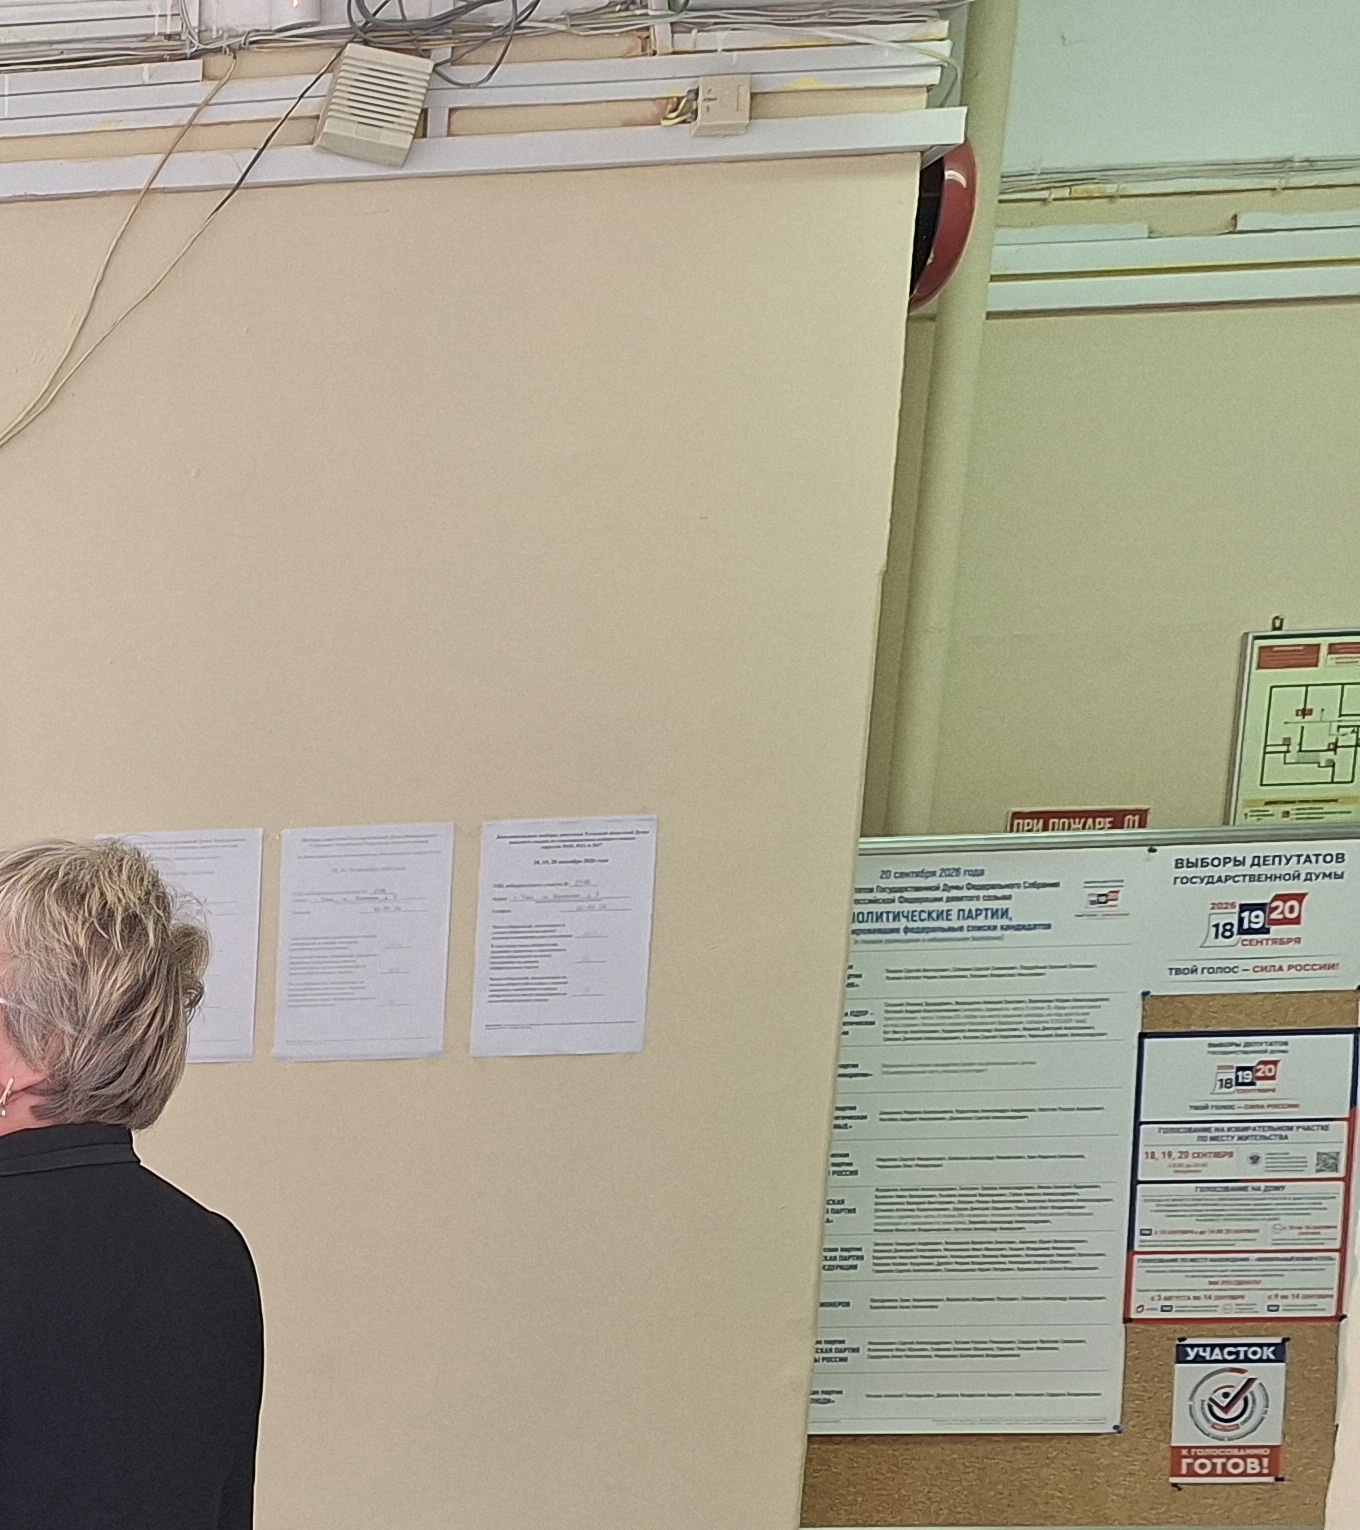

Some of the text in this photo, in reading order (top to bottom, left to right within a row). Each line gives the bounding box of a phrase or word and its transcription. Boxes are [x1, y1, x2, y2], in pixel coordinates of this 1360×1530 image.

[1012, 818, 1044, 833] ПРИ
[1048, 817, 1114, 832] ПОЖАРЕ
[1174, 852, 1346, 870] ВЫБОРЫ ДЕПУТАТОВ
[1173, 870, 1345, 885] ГОСУДАРСТВЕННОЙ ДУМЫ
[957, 907, 1013, 922] ПАРТИИ,
[1211, 900, 1300, 940] 18 19 20
[1240, 936, 1302, 947] СЕНТЯБРЯ
[1168, 964, 1198, 976] ТВОЙ
[1200, 965, 1240, 975] ГОЛОС
[1252, 964, 1284, 974] СИЛА
[1217, 1064, 1276, 1089] 18 19 20
[1185, 1346, 1276, 1361] УЧАСТОК
[1180, 1457, 1270, 1475] ГОТОВ!
